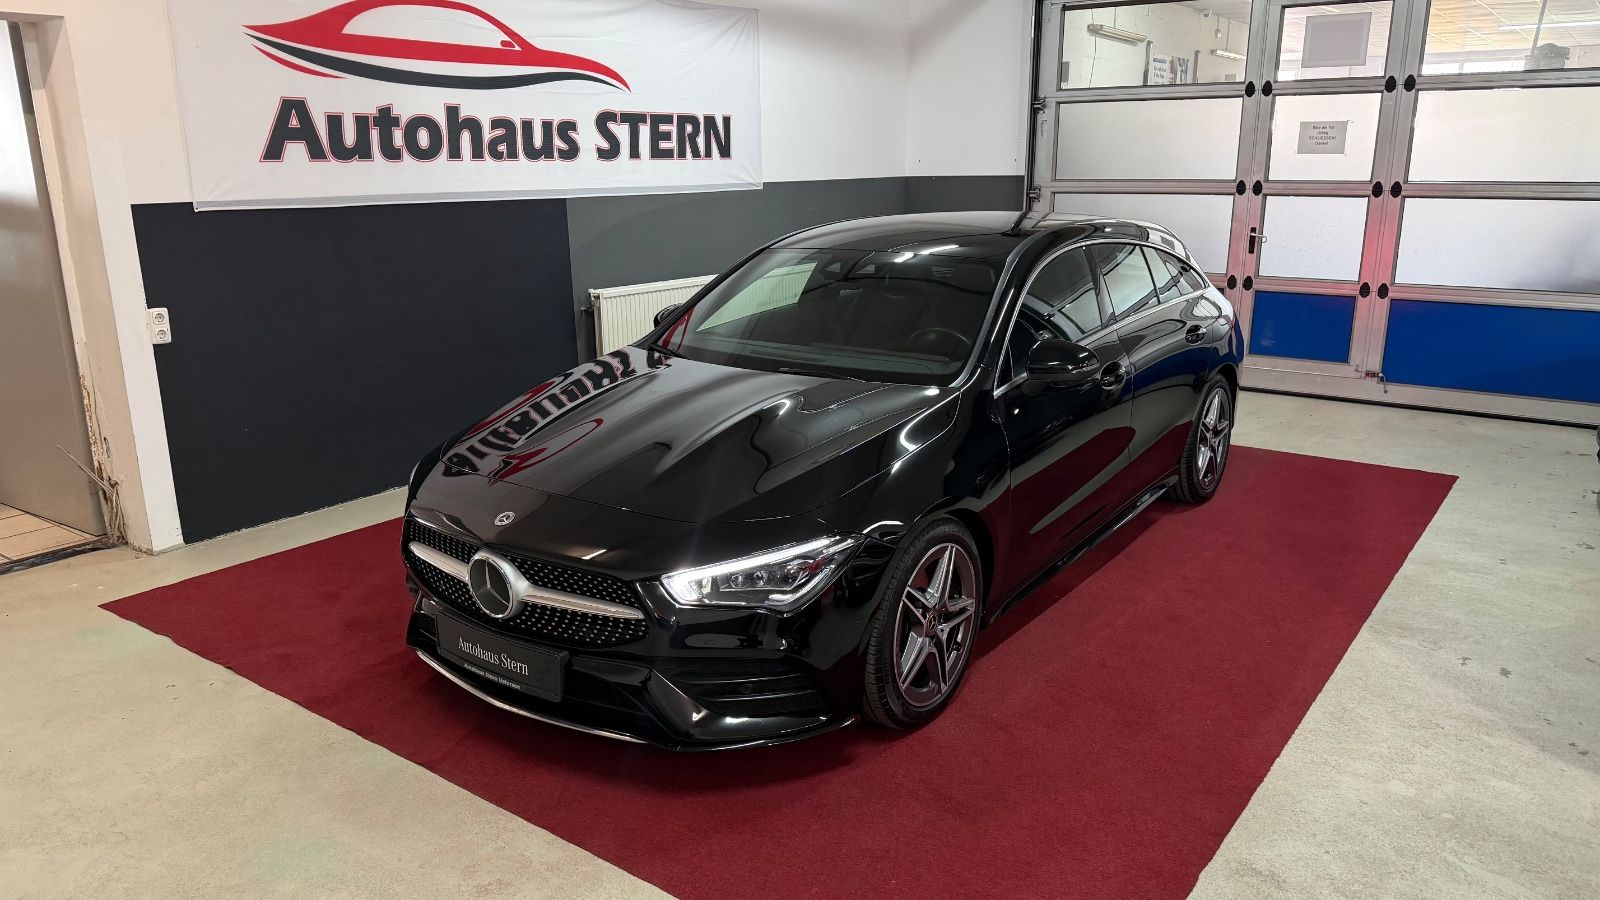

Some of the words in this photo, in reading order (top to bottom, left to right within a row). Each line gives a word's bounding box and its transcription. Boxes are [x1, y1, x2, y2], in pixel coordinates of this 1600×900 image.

[259, 96, 580, 163] Autohaus
[594, 109, 732, 162] STERN
[458, 636, 499, 665] Autohaus
[500, 653, 528, 676] Stern
